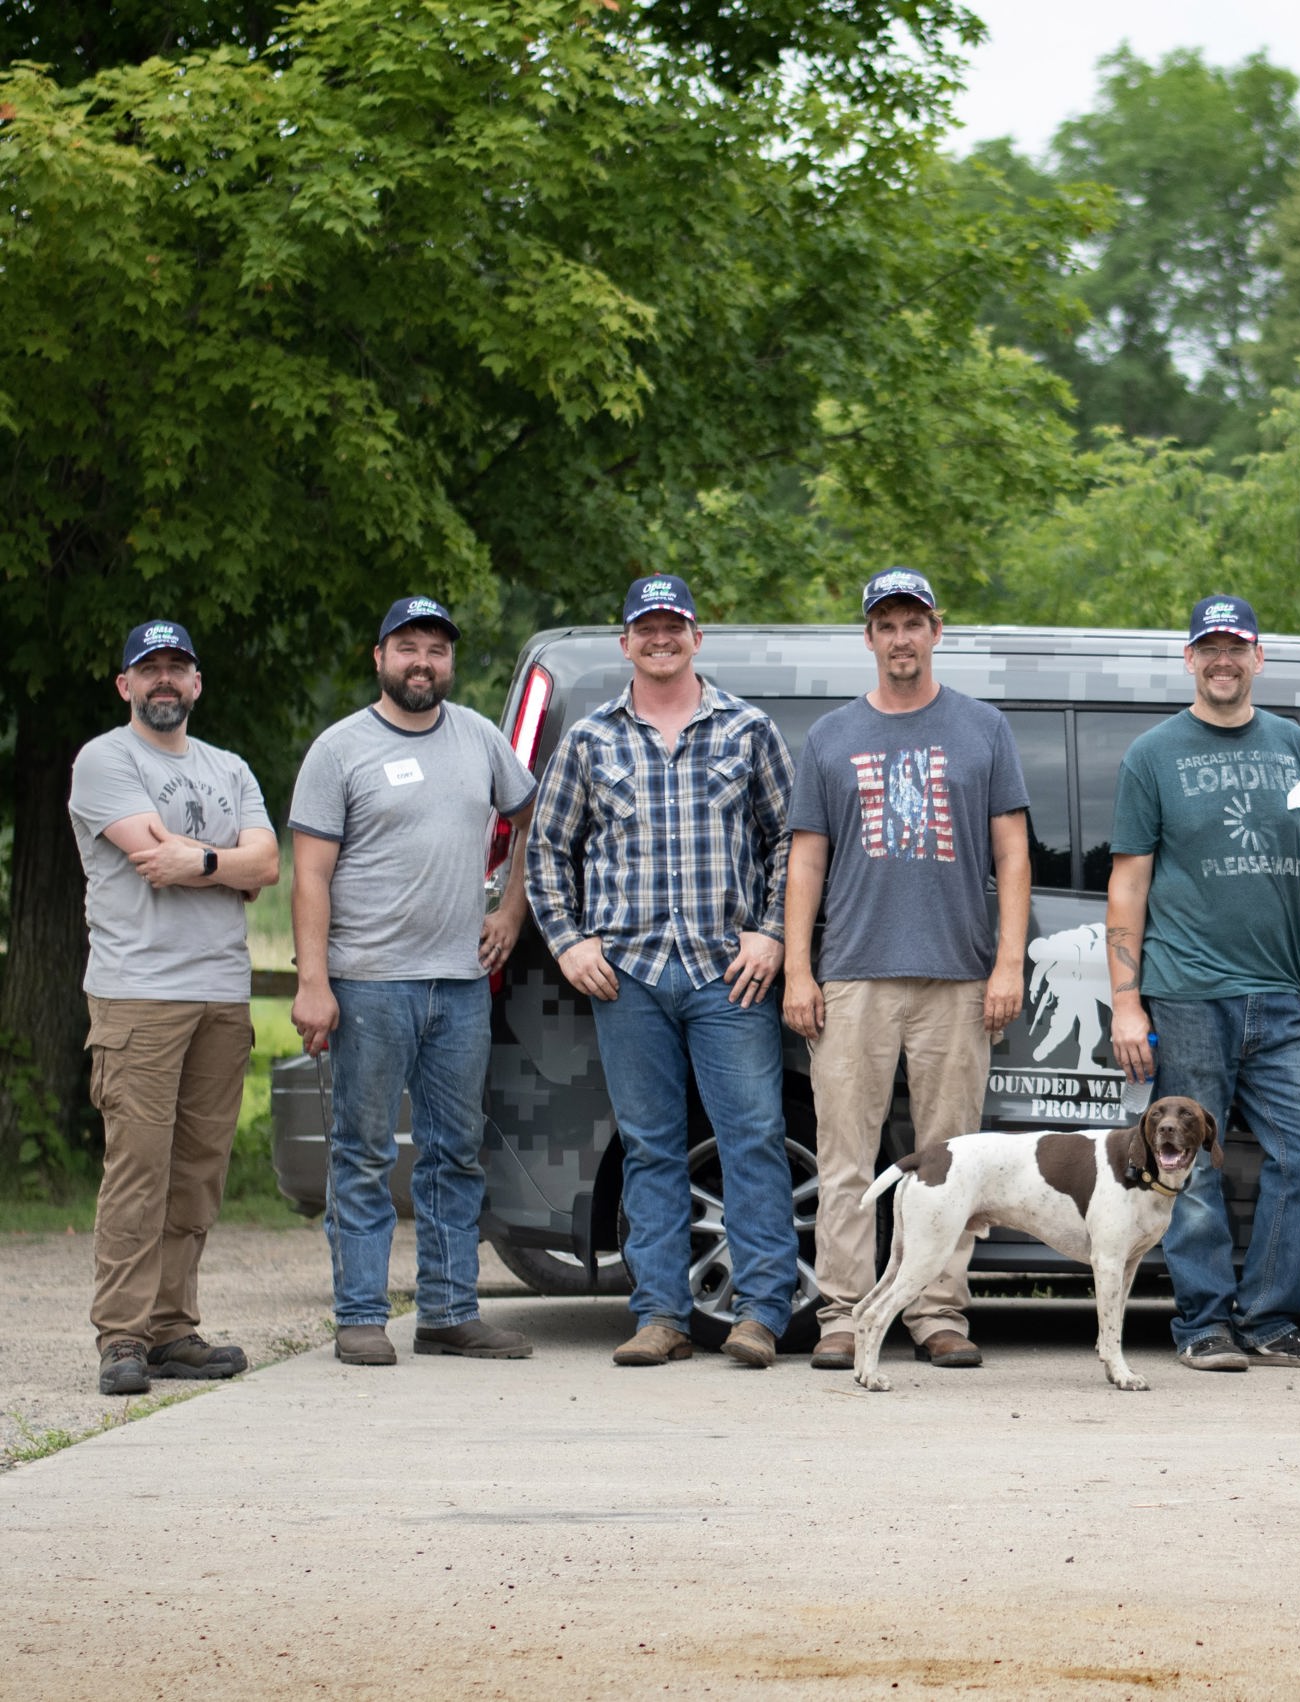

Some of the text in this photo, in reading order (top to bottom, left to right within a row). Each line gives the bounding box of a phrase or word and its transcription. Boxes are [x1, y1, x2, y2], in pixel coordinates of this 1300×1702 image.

[1176, 750, 1297, 770] SARCASTIC COMMENT
[1179, 763, 1300, 797] LOADING
[850, 746, 956, 862] USA
[1200, 855, 1272, 878] PLEASE
[988, 1074, 1080, 1097] OUNDED
[1031, 1099, 1127, 1121] PROJECT
